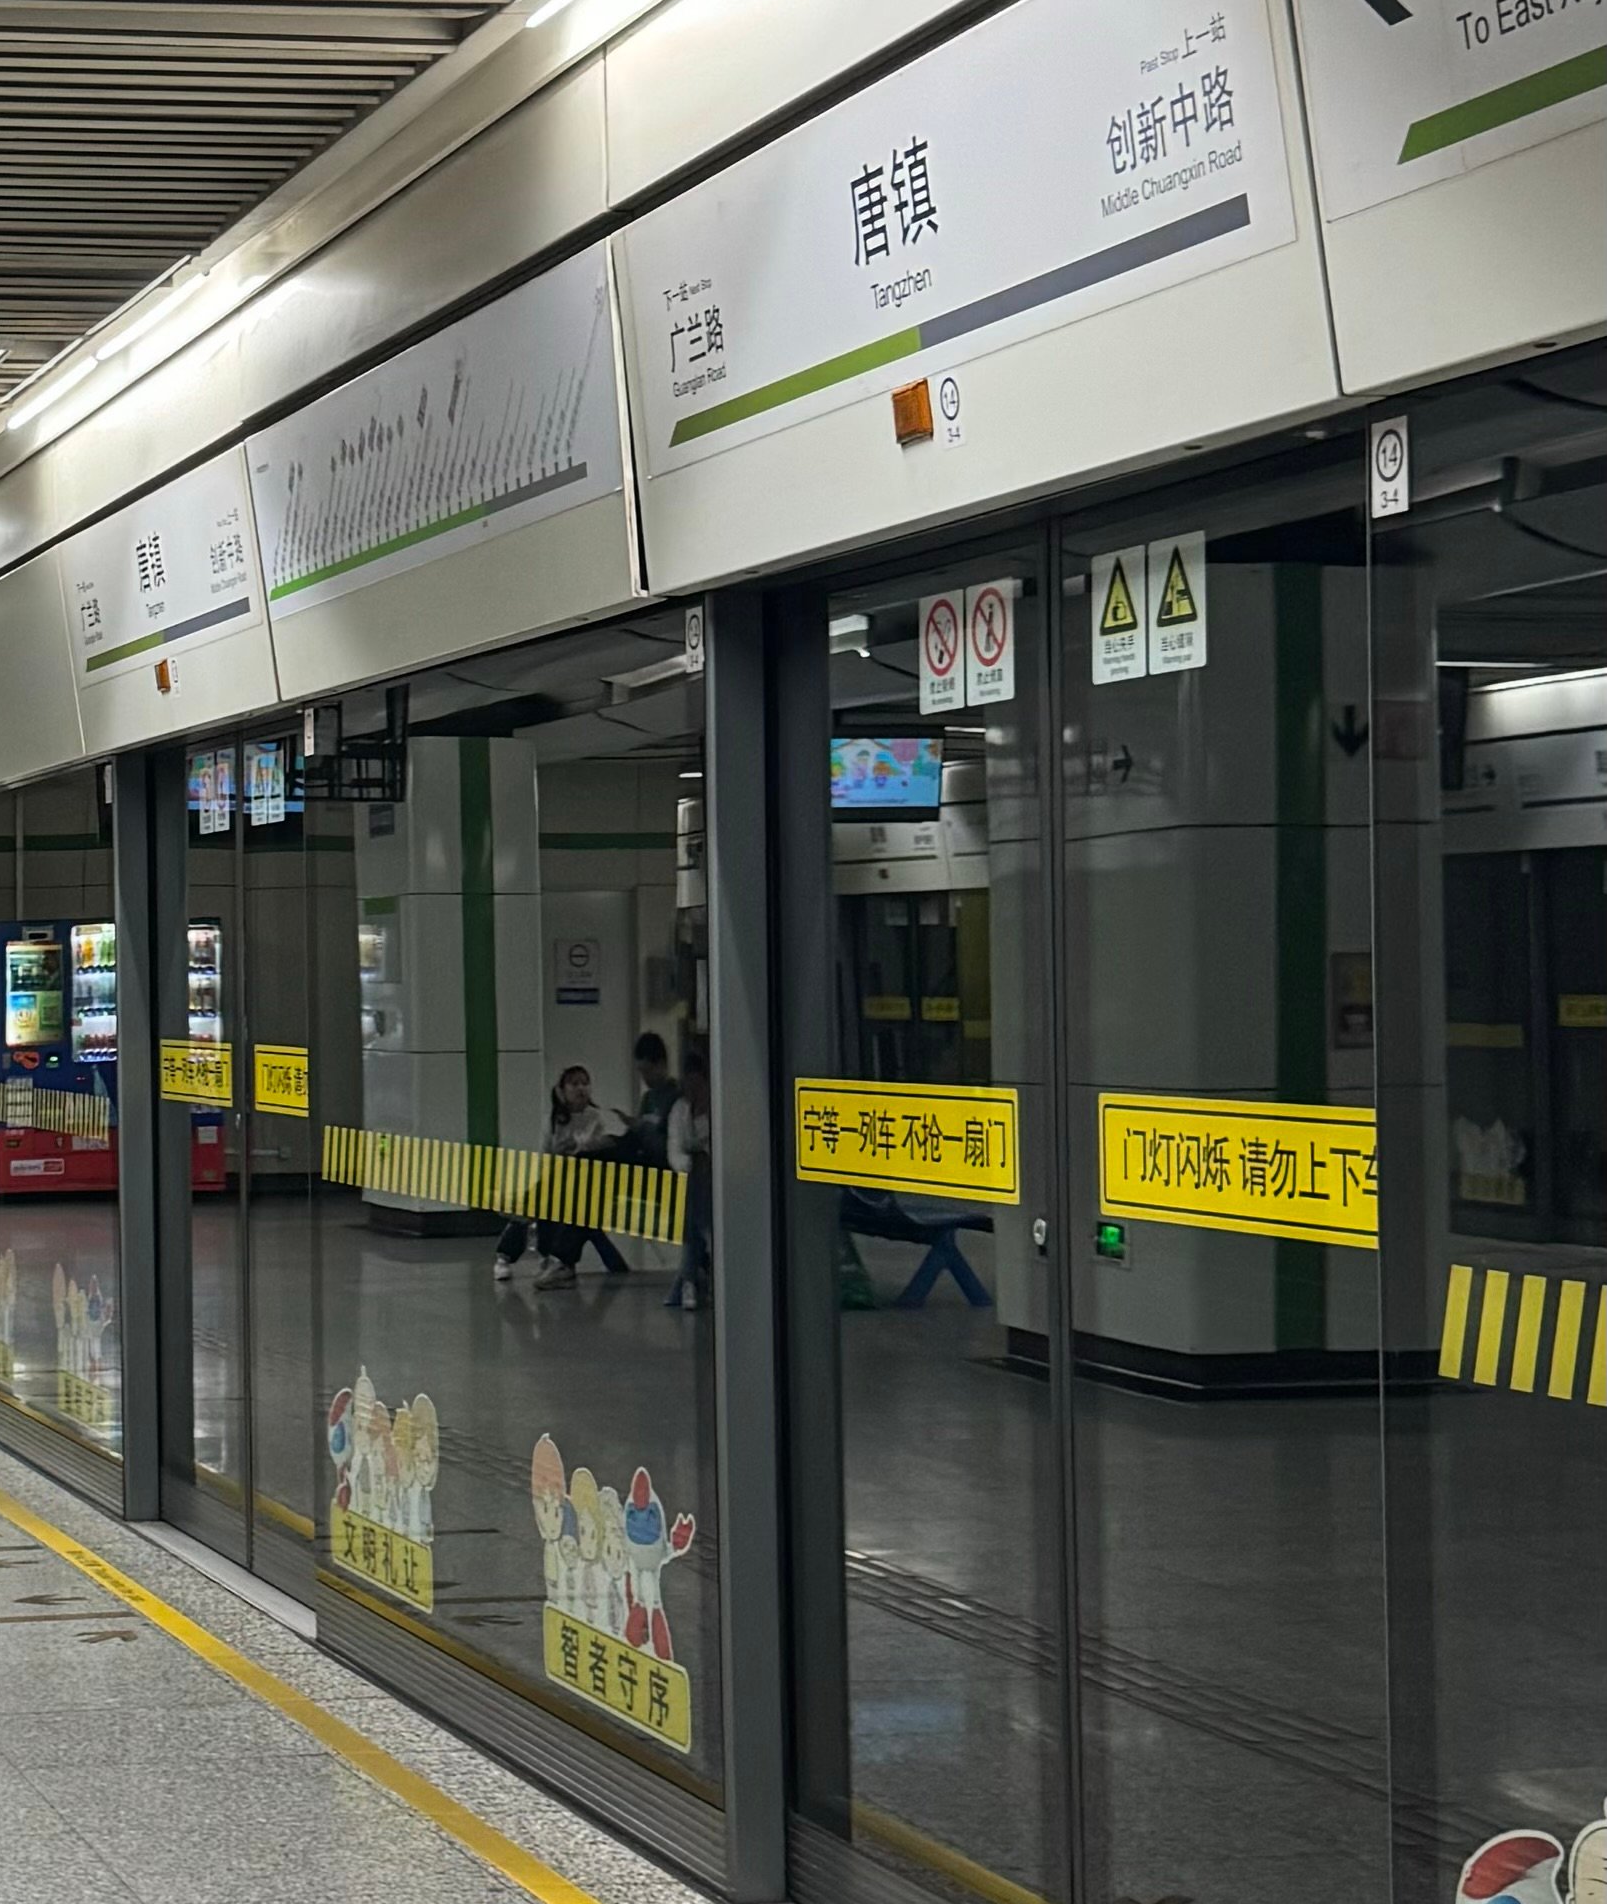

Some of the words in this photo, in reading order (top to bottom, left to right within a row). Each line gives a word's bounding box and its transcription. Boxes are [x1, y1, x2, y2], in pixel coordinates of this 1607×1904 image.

[1181, 11, 1227, 59] 上一站
[1456, 11, 1490, 50] To
[1105, 65, 1235, 175] 创新中路
[849, 135, 939, 267] 唐镇
[1100, 187, 1139, 218] Middle
[1141, 158, 1207, 201] Chuangxin
[1208, 139, 1243, 174] Road
[870, 268, 933, 310] Tangzhen
[670, 304, 724, 374] 广兰路
[1380, 488, 1399, 509] 3-4
[803, 1104, 897, 1160] 宁等一列车
[901, 1112, 1006, 1168] 不抢一扇门
[1123, 1127, 1232, 1193] 门灯闪烁
[342, 1514, 419, 1595] 文明礼让
[559, 1618, 670, 1729] 智者守序
